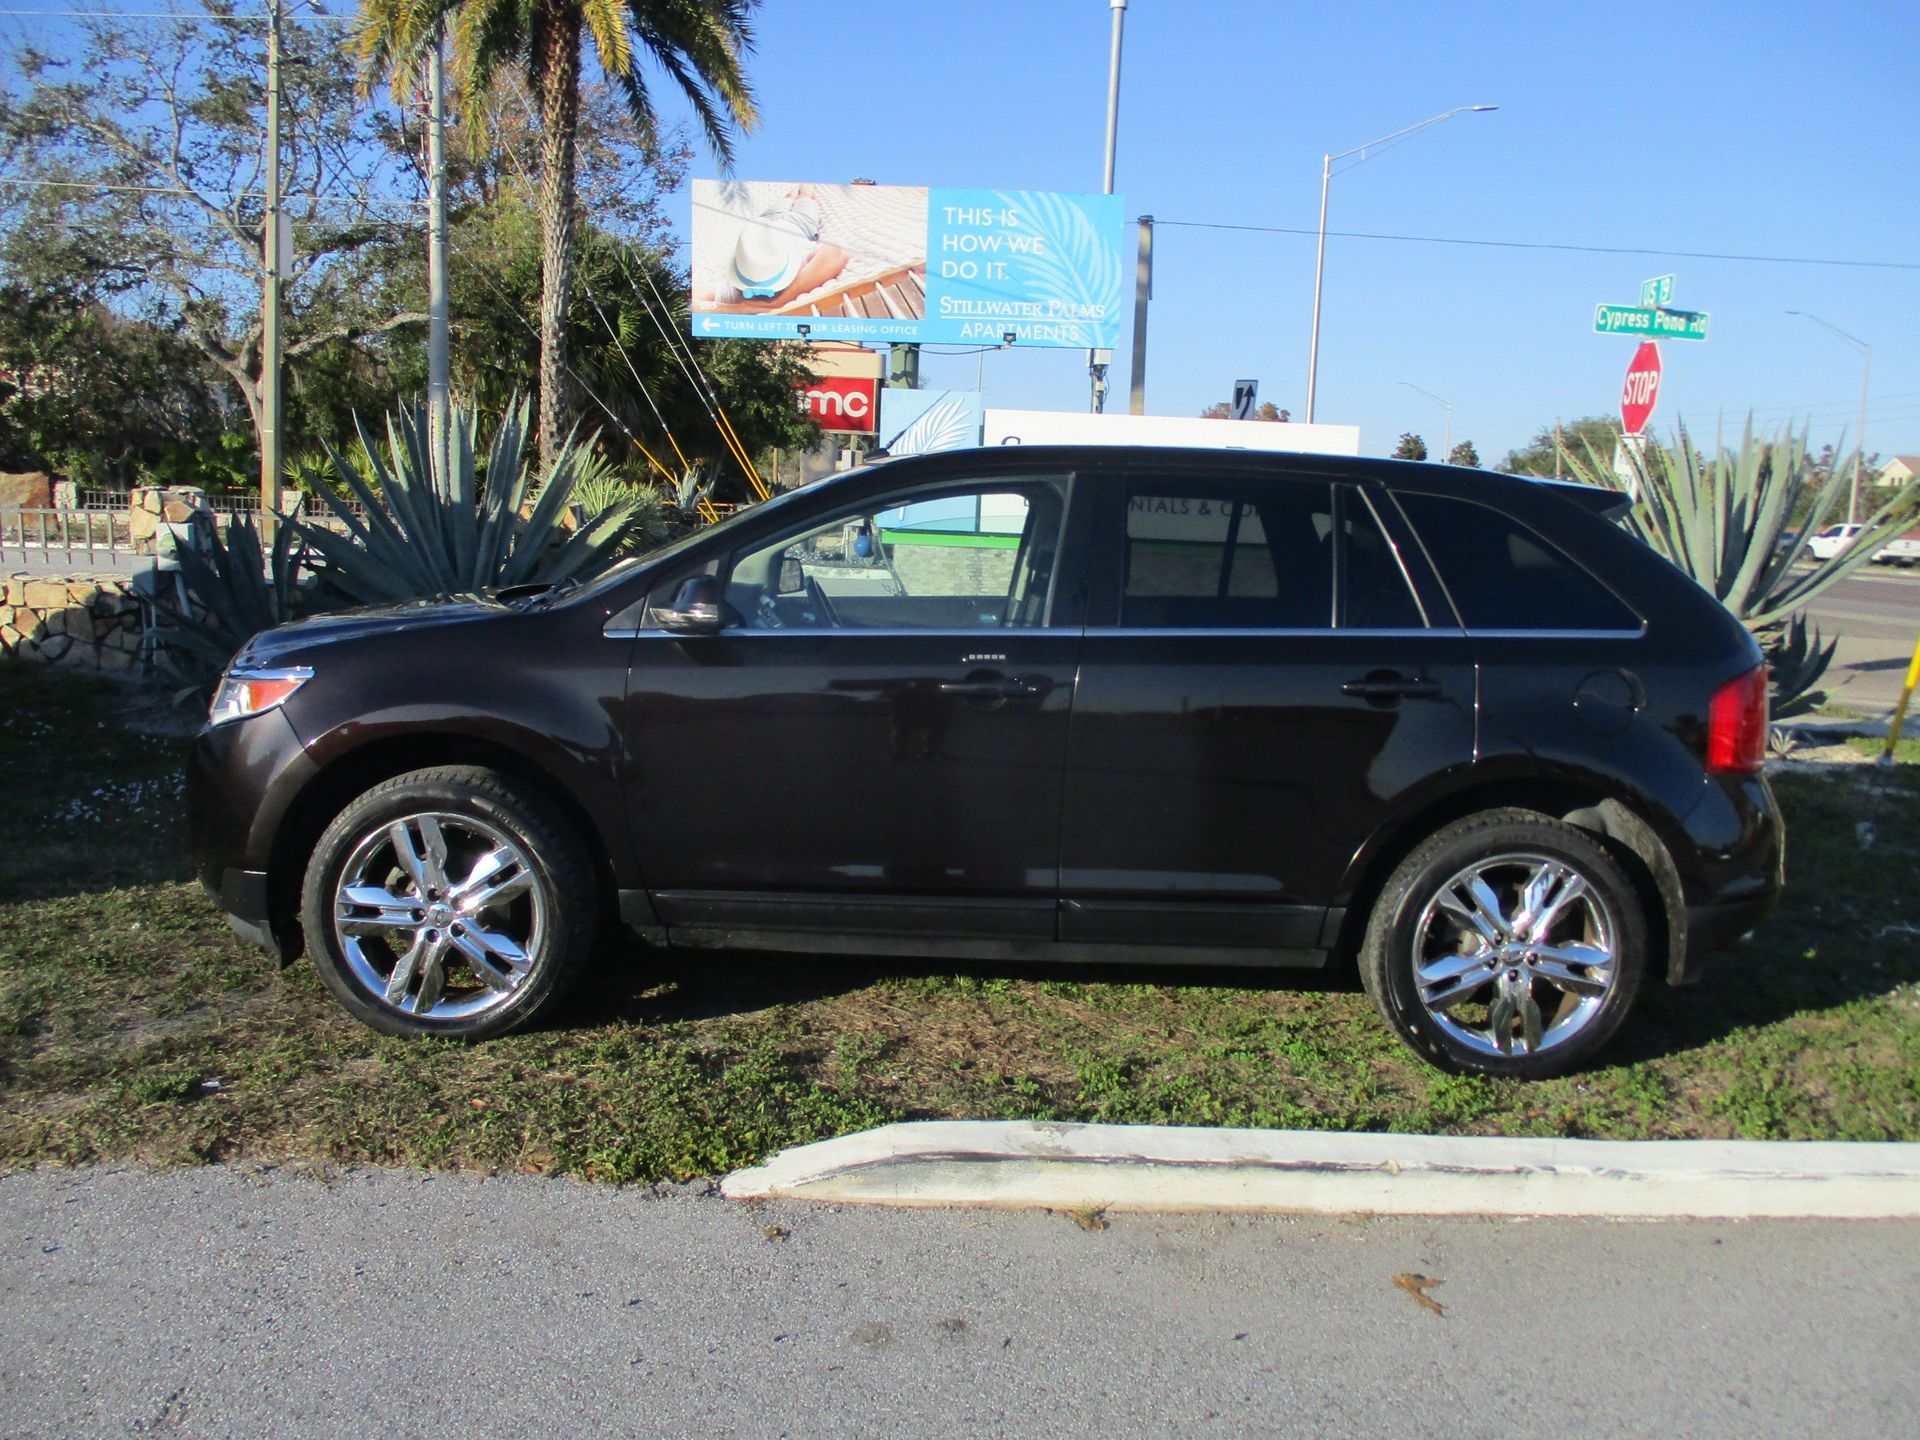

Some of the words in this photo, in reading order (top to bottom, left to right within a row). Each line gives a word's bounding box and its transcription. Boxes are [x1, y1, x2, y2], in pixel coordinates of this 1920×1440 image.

[943, 206, 993, 226] THIS
[1001, 208, 1018, 228] IS
[943, 233, 1002, 253] HOW
[1007, 235, 1045, 255] WE
[942, 260, 978, 279] DO
[987, 262, 1011, 280] IT.
[1643, 281, 1658, 306] US
[939, 296, 1042, 316] STILLWATER
[1049, 300, 1105, 319] PALMS
[725, 320, 754, 331] TURN
[758, 321, 782, 331] LEFT
[831, 324, 877, 334] LEASING
[880, 325, 919, 336] OFFICE
[1597, 306, 1650, 330] Cypress
[1690, 315, 1707, 333] Rd
[960, 322, 1081, 341] APARTMENTS
[1623, 371, 1658, 406] STOP
[1197, 501, 1212, 516] &
